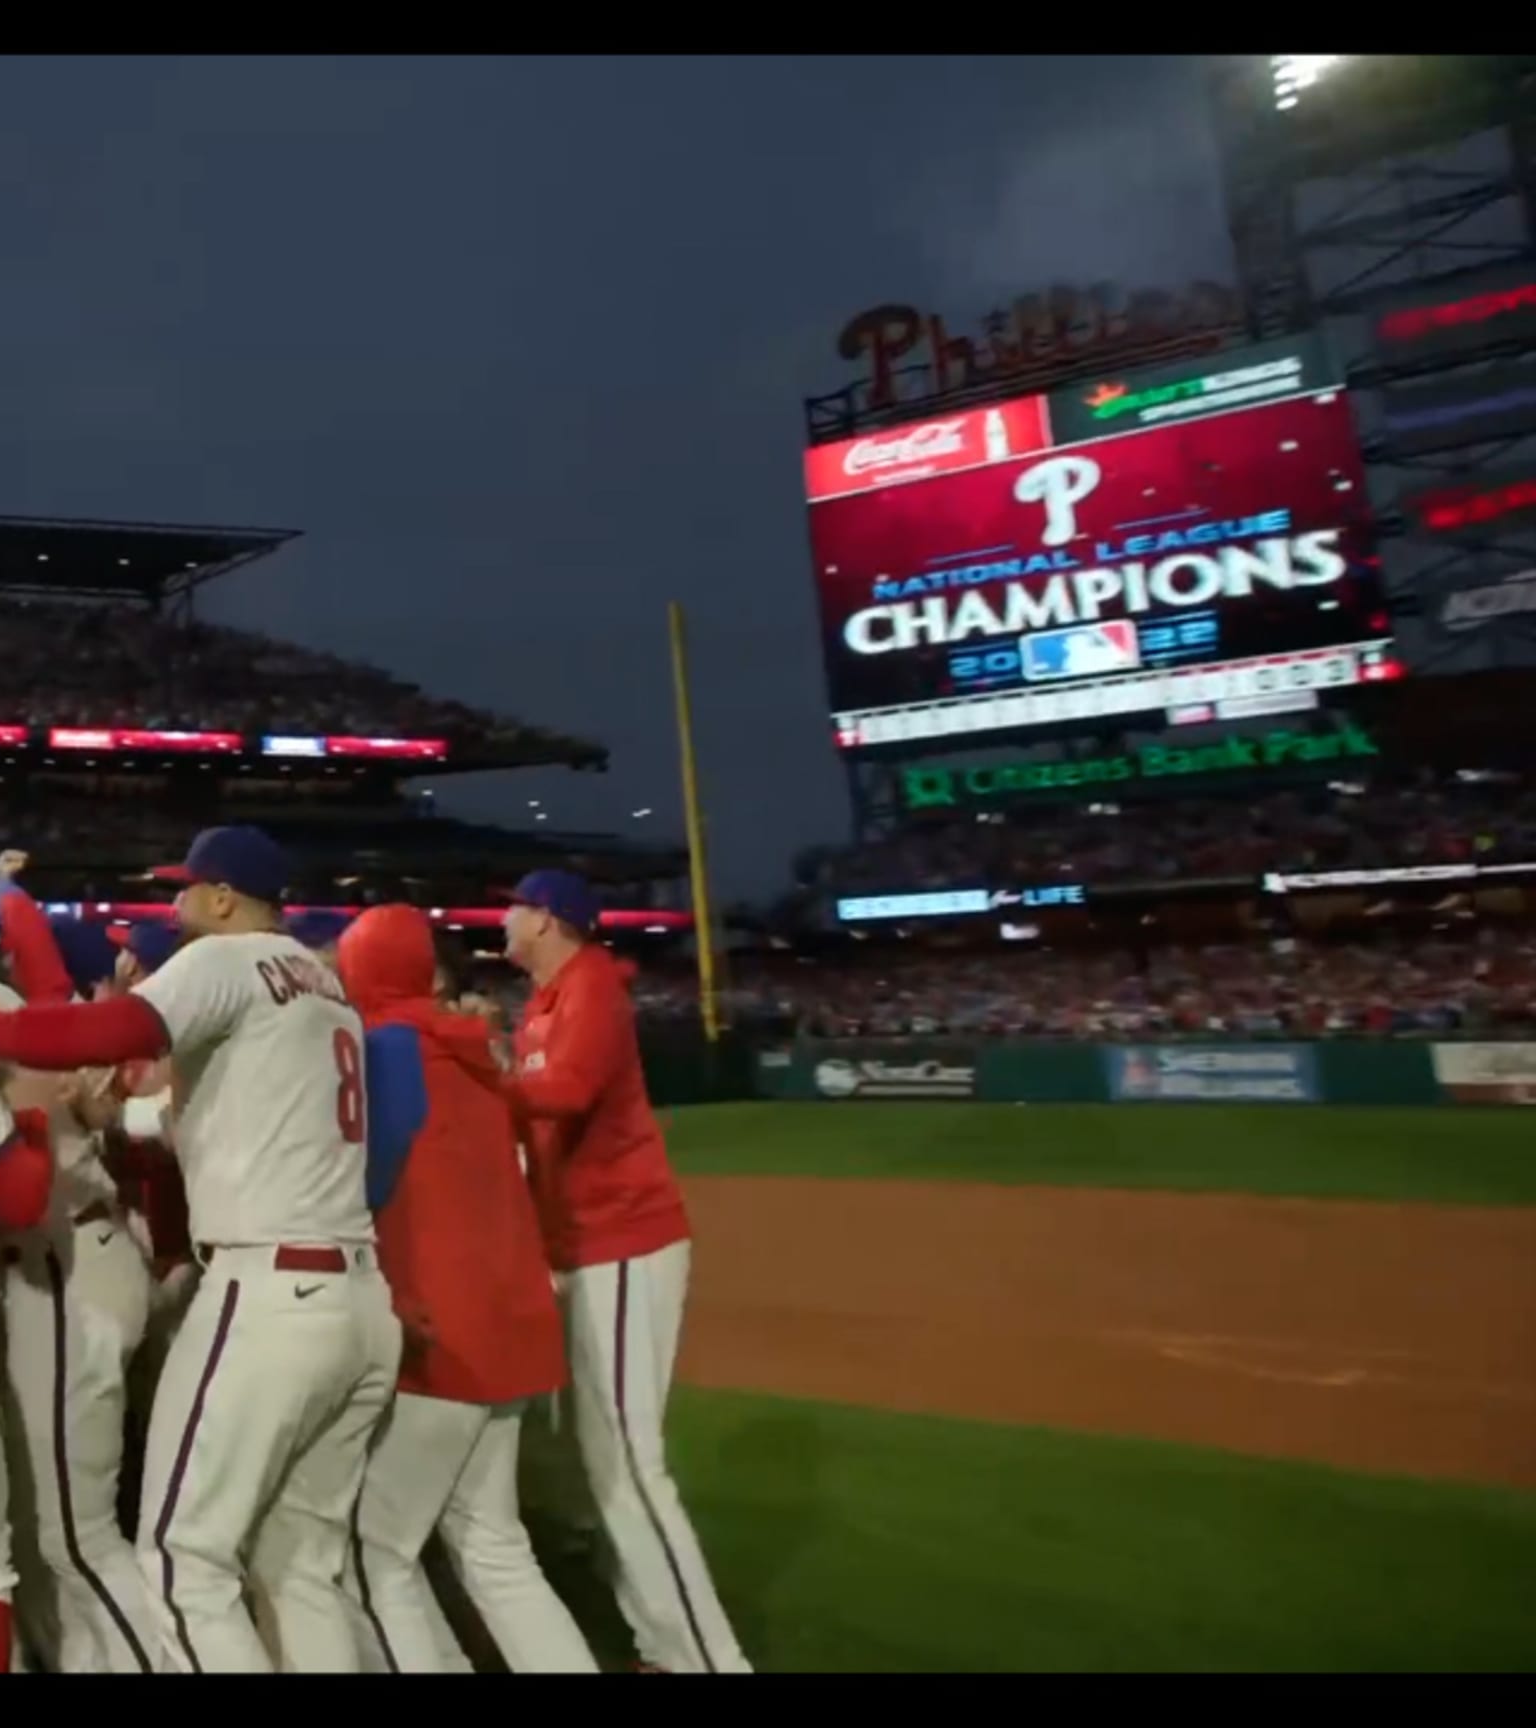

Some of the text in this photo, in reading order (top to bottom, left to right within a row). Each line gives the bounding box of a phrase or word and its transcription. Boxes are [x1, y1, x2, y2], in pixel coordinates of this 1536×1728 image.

[844, 529, 1346, 654] CHAMPIONS
[873, 508, 1291, 600] NATIONAL LEAGUE
[966, 724, 1378, 794] Citizens Bank Park
[332, 1026, 364, 1144] 8
